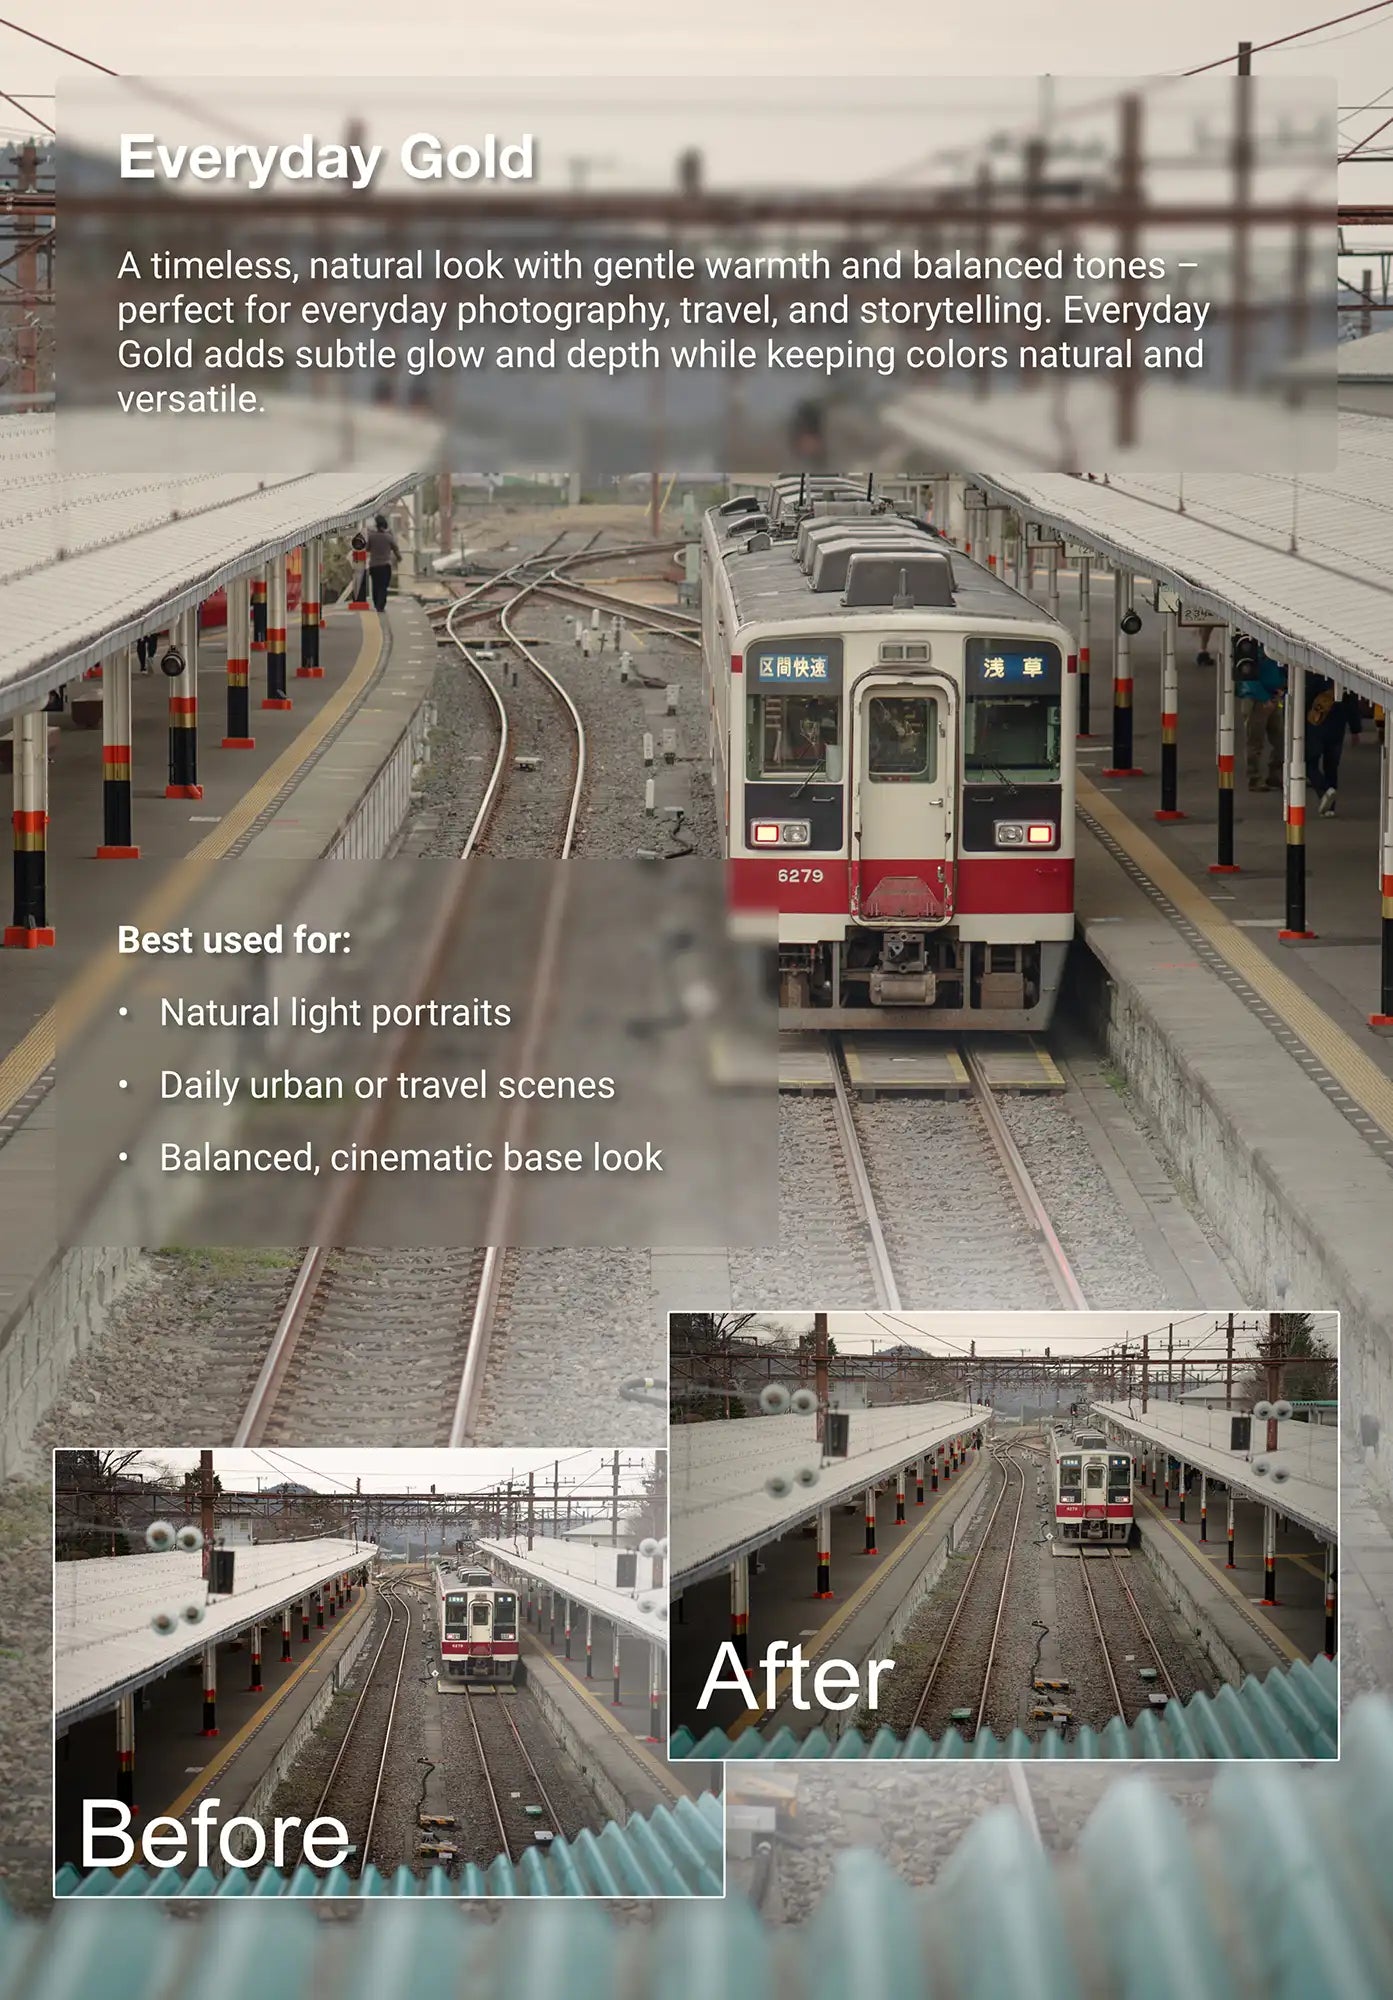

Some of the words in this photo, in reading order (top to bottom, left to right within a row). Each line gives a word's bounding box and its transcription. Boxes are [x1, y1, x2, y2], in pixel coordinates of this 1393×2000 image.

[759, 656, 828, 677] 区間快速
[983, 657, 1044, 678] 浅草
[777, 868, 824, 883] 6279
